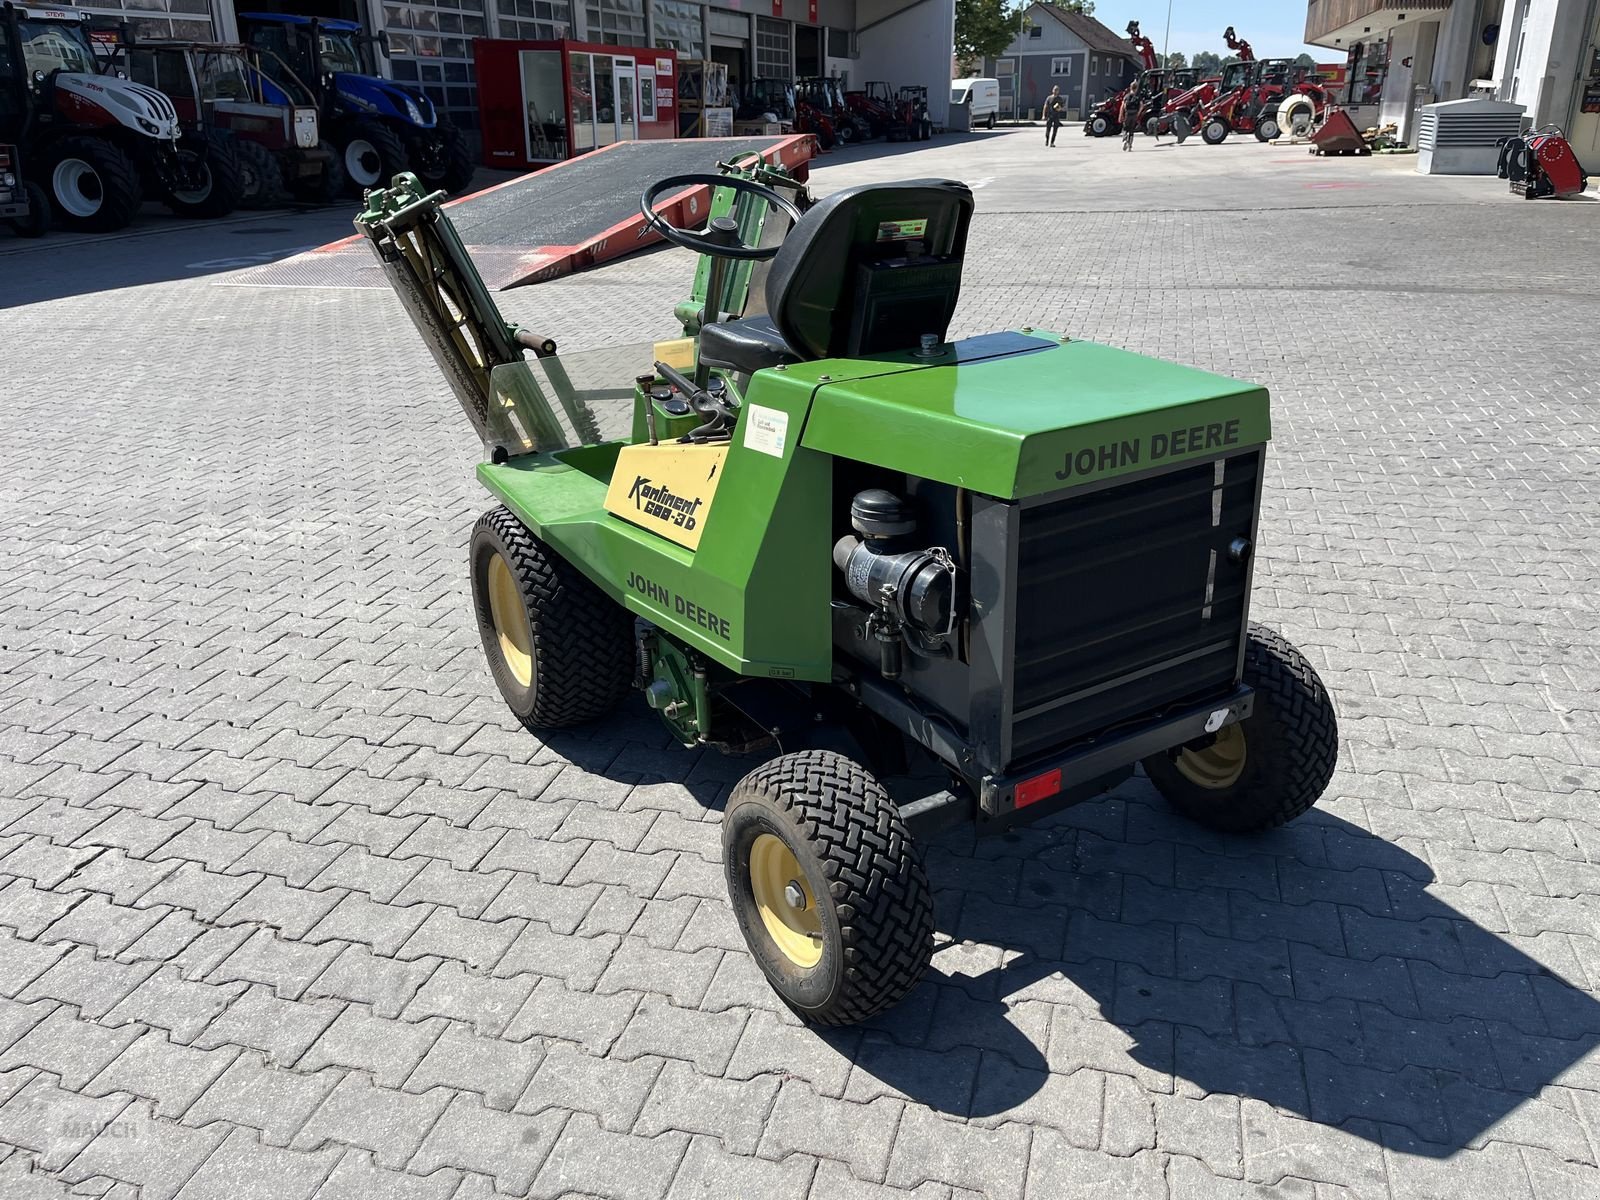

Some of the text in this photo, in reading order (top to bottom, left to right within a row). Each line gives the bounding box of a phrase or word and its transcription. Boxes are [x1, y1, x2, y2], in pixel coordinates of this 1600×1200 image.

[87, 82, 104, 93] STEYR
[1055, 419, 1240, 481] JOHN DEERE
[628, 475, 703, 516] Kontinent
[626, 571, 731, 642] JOHN DEERE
